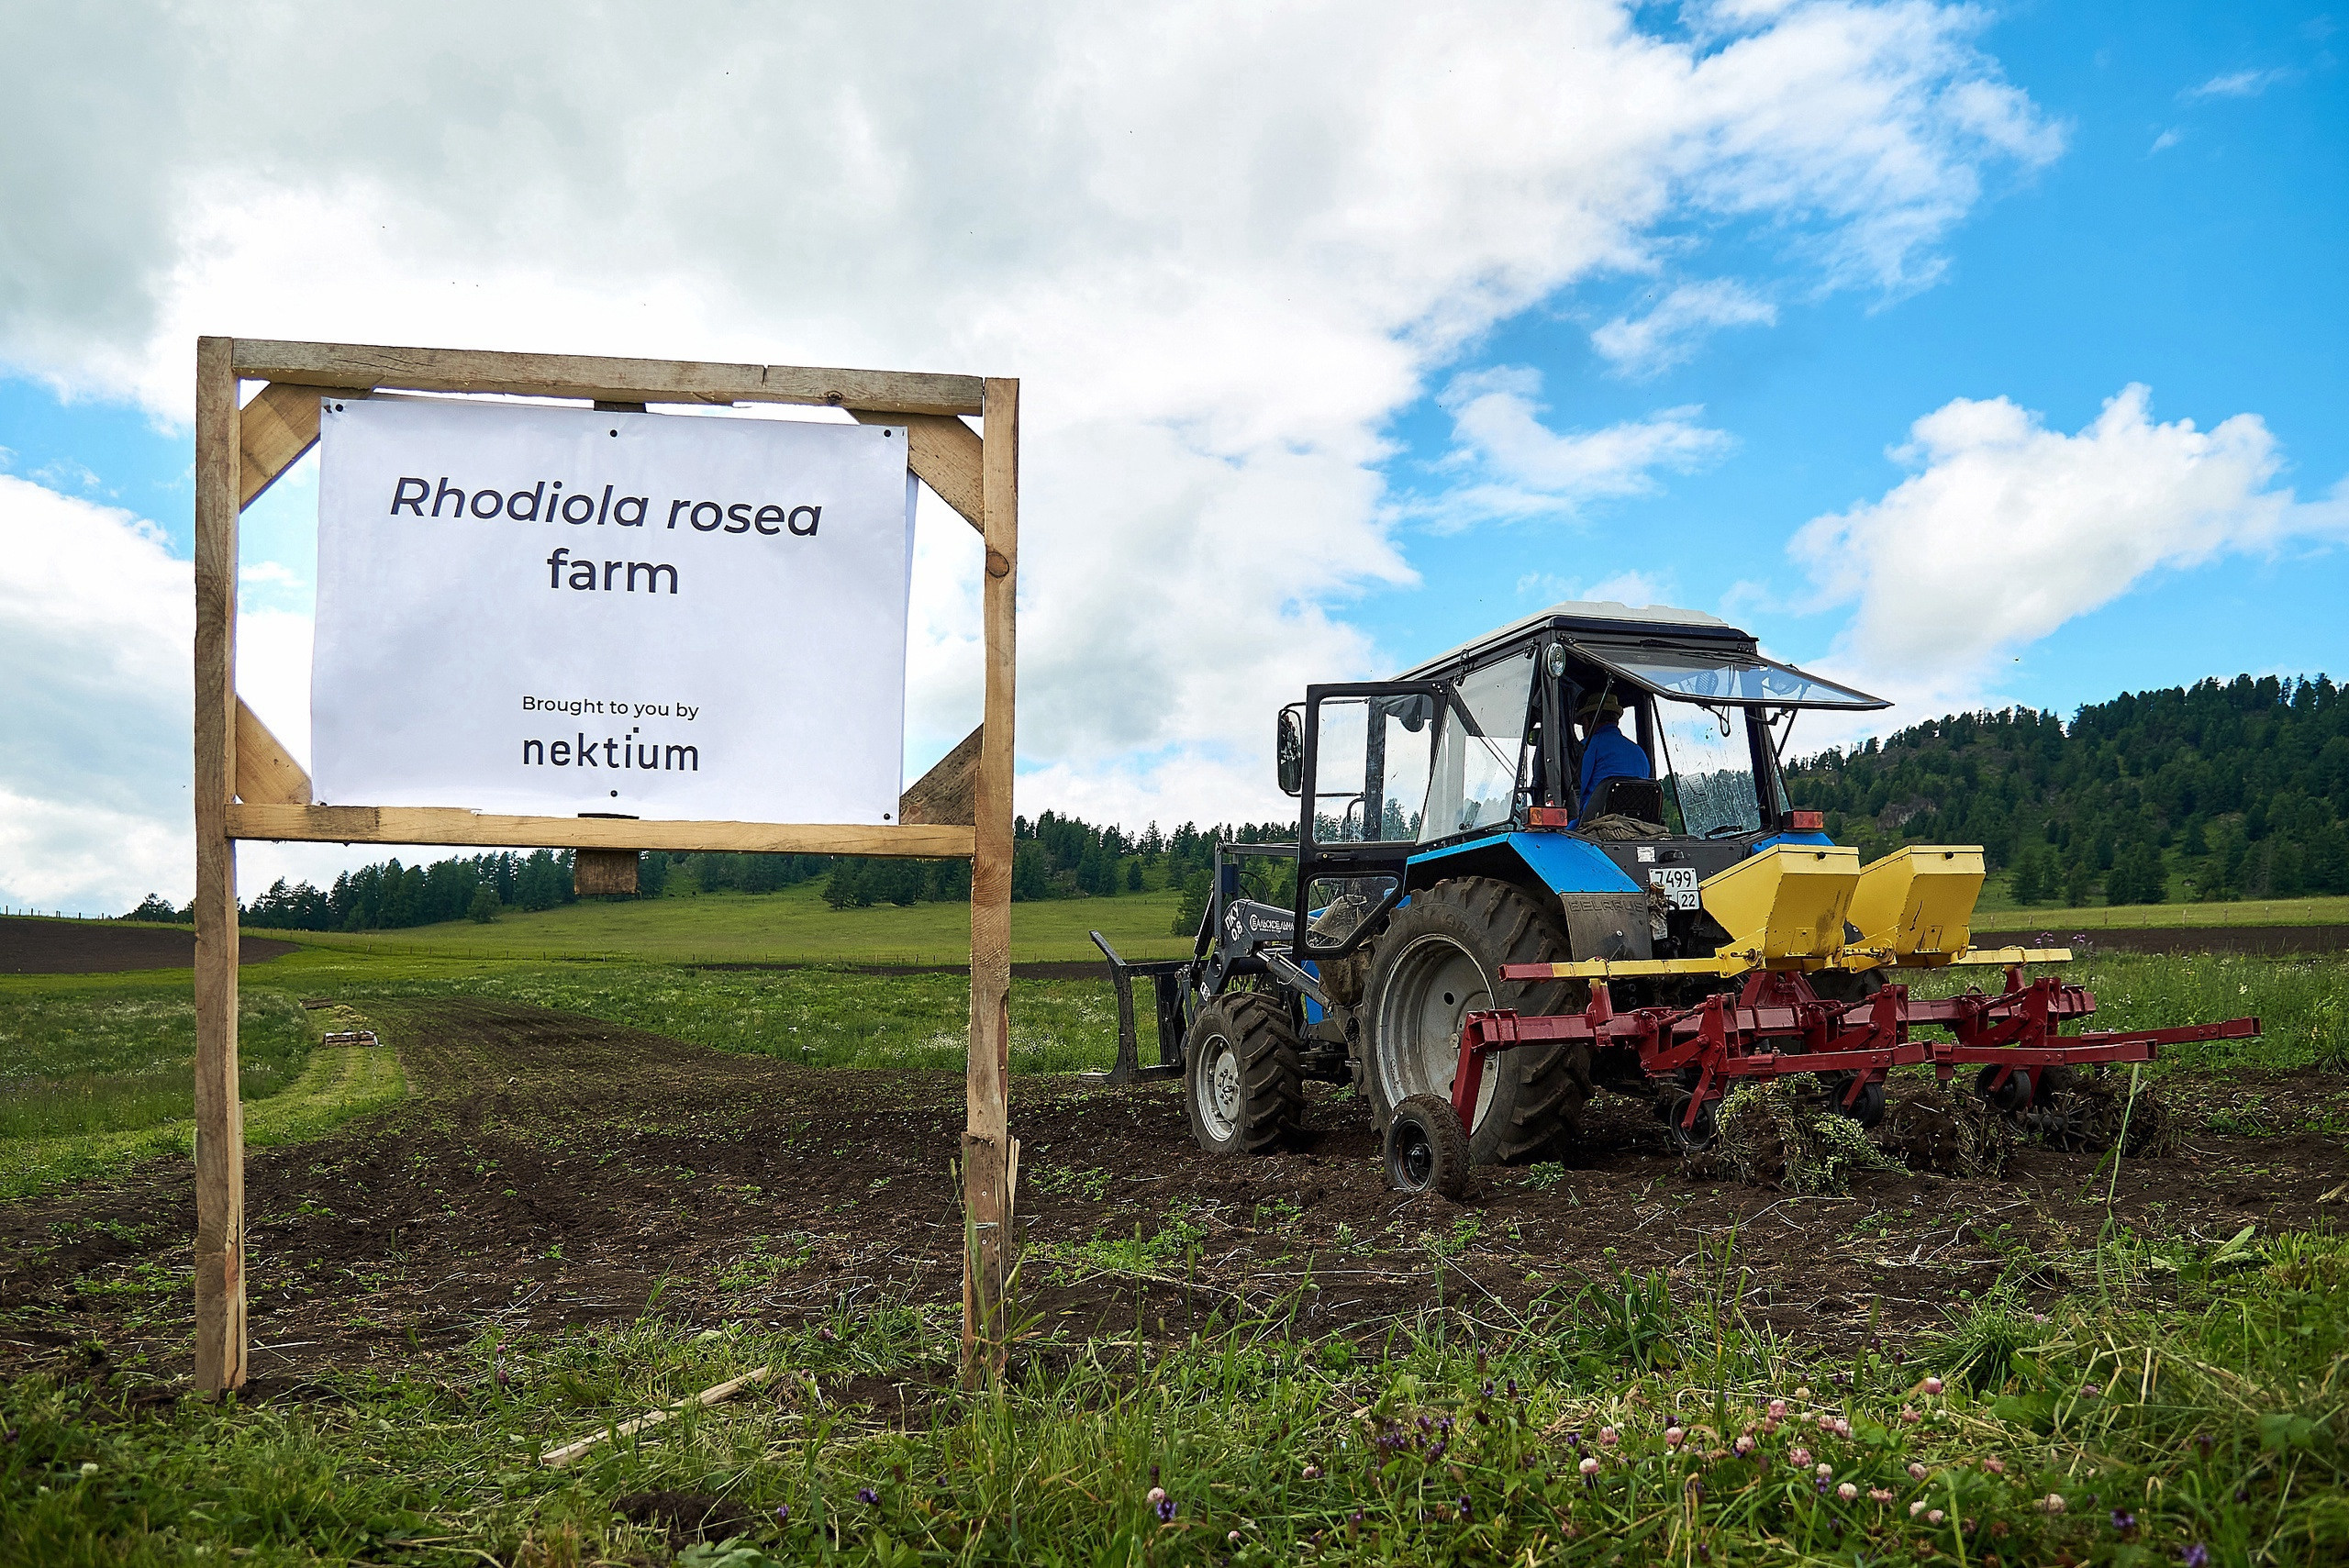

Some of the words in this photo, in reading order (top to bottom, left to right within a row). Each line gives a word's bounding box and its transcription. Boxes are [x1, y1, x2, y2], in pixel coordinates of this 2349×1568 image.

[390, 476, 650, 528] Rhodiola
[666, 499, 822, 537] rosea
[546, 547, 678, 595] farm
[522, 695, 605, 717] Brought
[609, 700, 629, 715] to
[633, 703, 670, 718] you
[676, 702, 700, 721] by
[523, 727, 698, 772] nektium
[1655, 871, 1691, 887] 7499
[1569, 900, 1643, 912] BELARUS
[1681, 894, 1696, 907] 22
